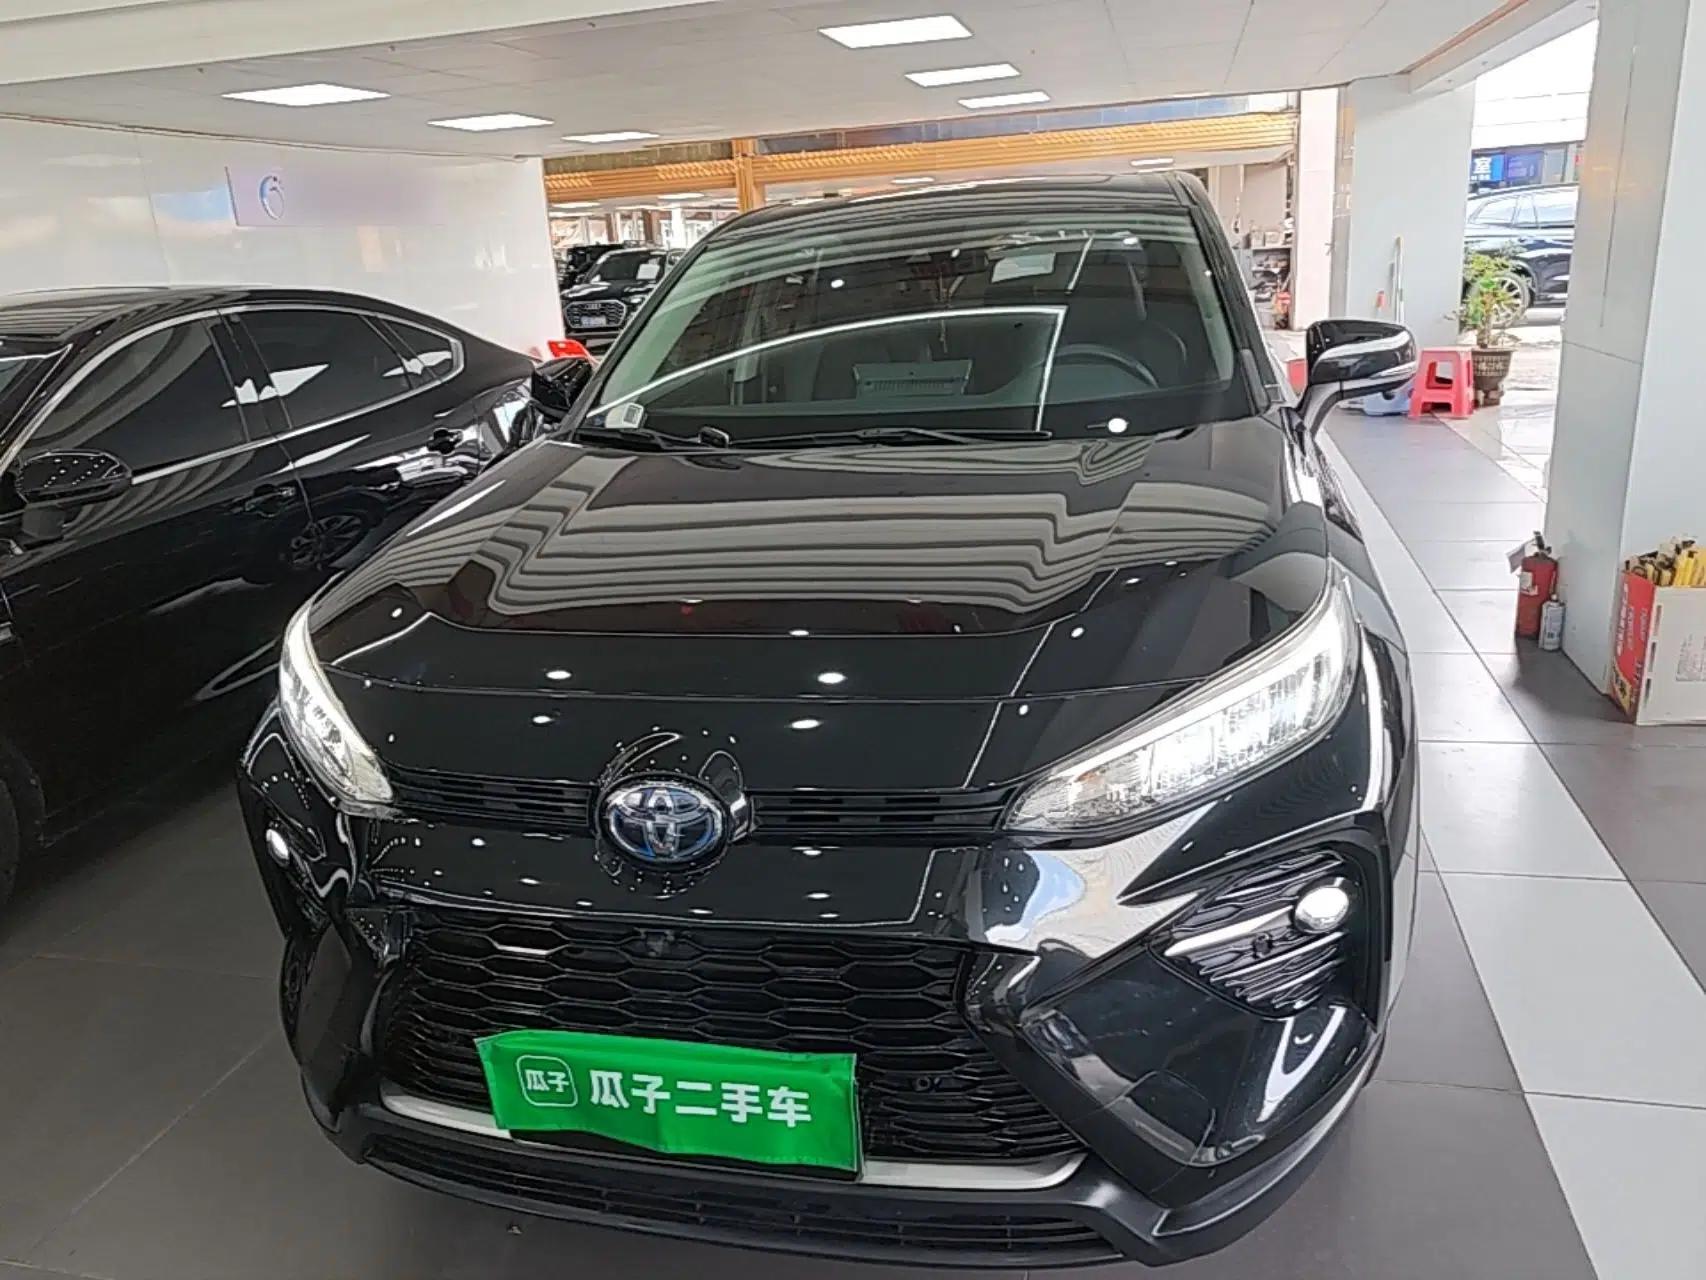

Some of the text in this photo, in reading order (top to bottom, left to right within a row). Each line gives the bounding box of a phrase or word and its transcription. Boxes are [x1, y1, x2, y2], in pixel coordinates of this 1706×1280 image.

[525, 1069, 570, 1093] 瓜子
[590, 1070, 812, 1127] 瓜子二手车
